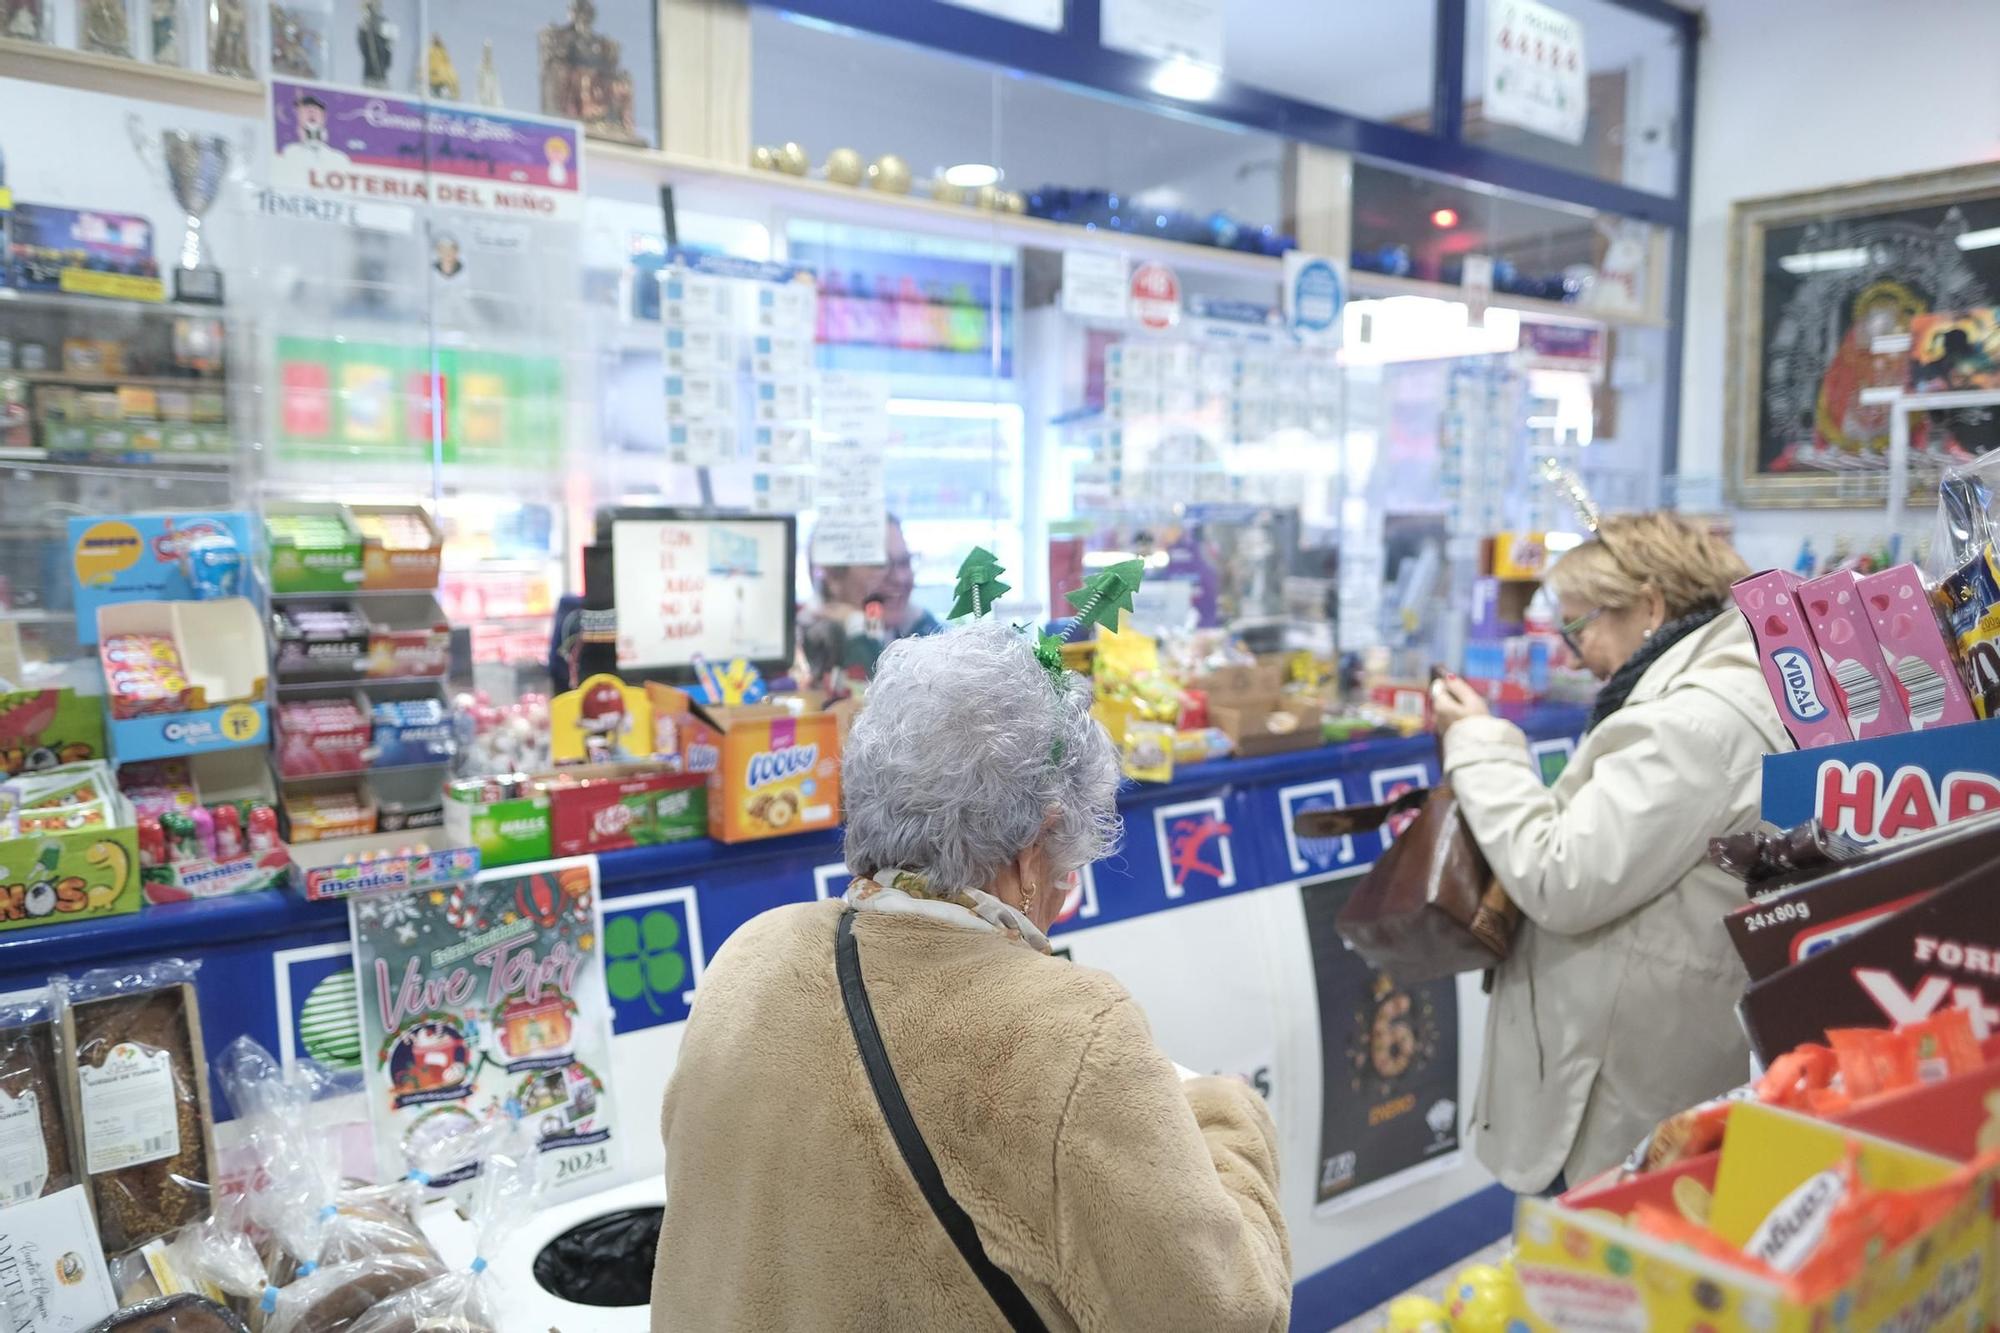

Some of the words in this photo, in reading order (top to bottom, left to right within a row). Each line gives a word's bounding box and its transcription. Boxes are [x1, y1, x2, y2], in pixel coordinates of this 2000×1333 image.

[437, 184, 483, 205] DEL
[1783, 656, 1815, 714] VIDAL
[184, 861, 254, 885] mentos
[321, 871, 404, 893] mentos
[1745, 901, 1810, 932] 24x80g
[375, 947, 477, 1033] Vive
[556, 1148, 608, 1178] 2024
